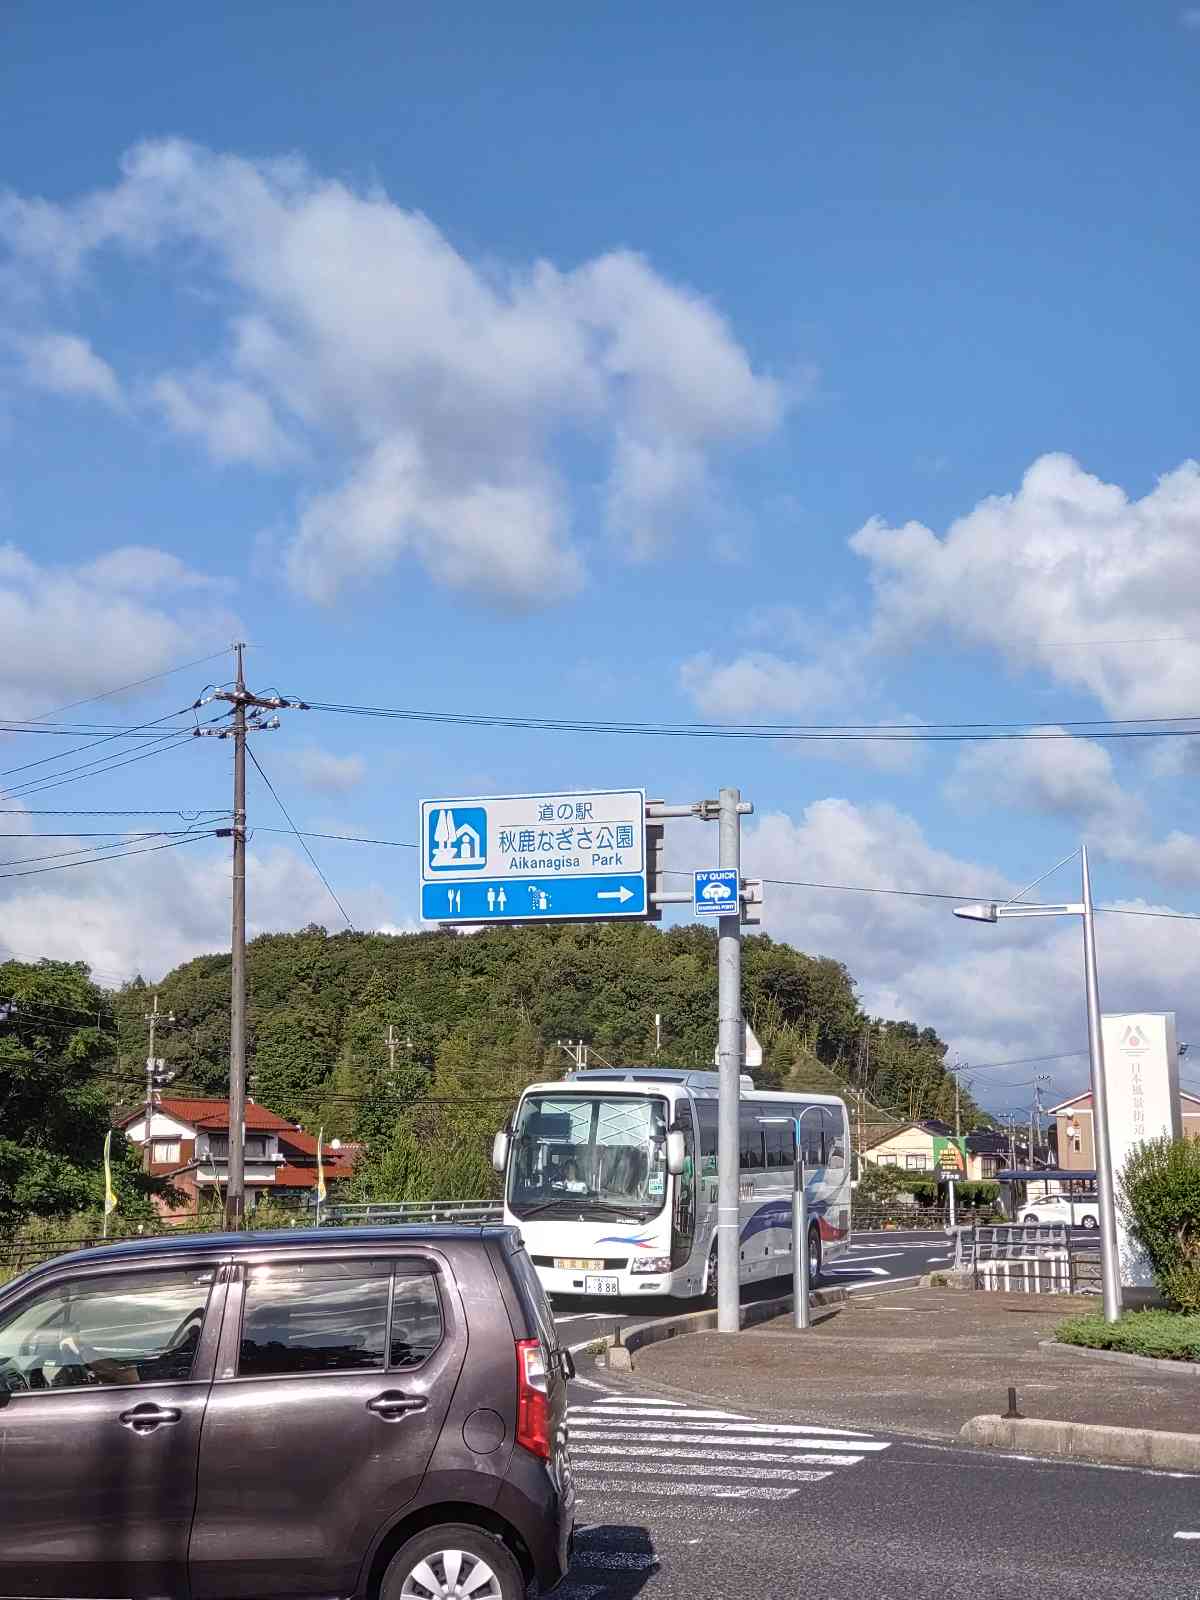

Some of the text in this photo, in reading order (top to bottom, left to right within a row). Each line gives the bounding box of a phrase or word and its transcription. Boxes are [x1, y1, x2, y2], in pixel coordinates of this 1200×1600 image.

[538, 802, 594, 822] 道の駅
[498, 825, 634, 853] 秋鹿なぎさ公園
[509, 853, 623, 870] Aikanagisa Park
[709, 872, 736, 880] QUICK
